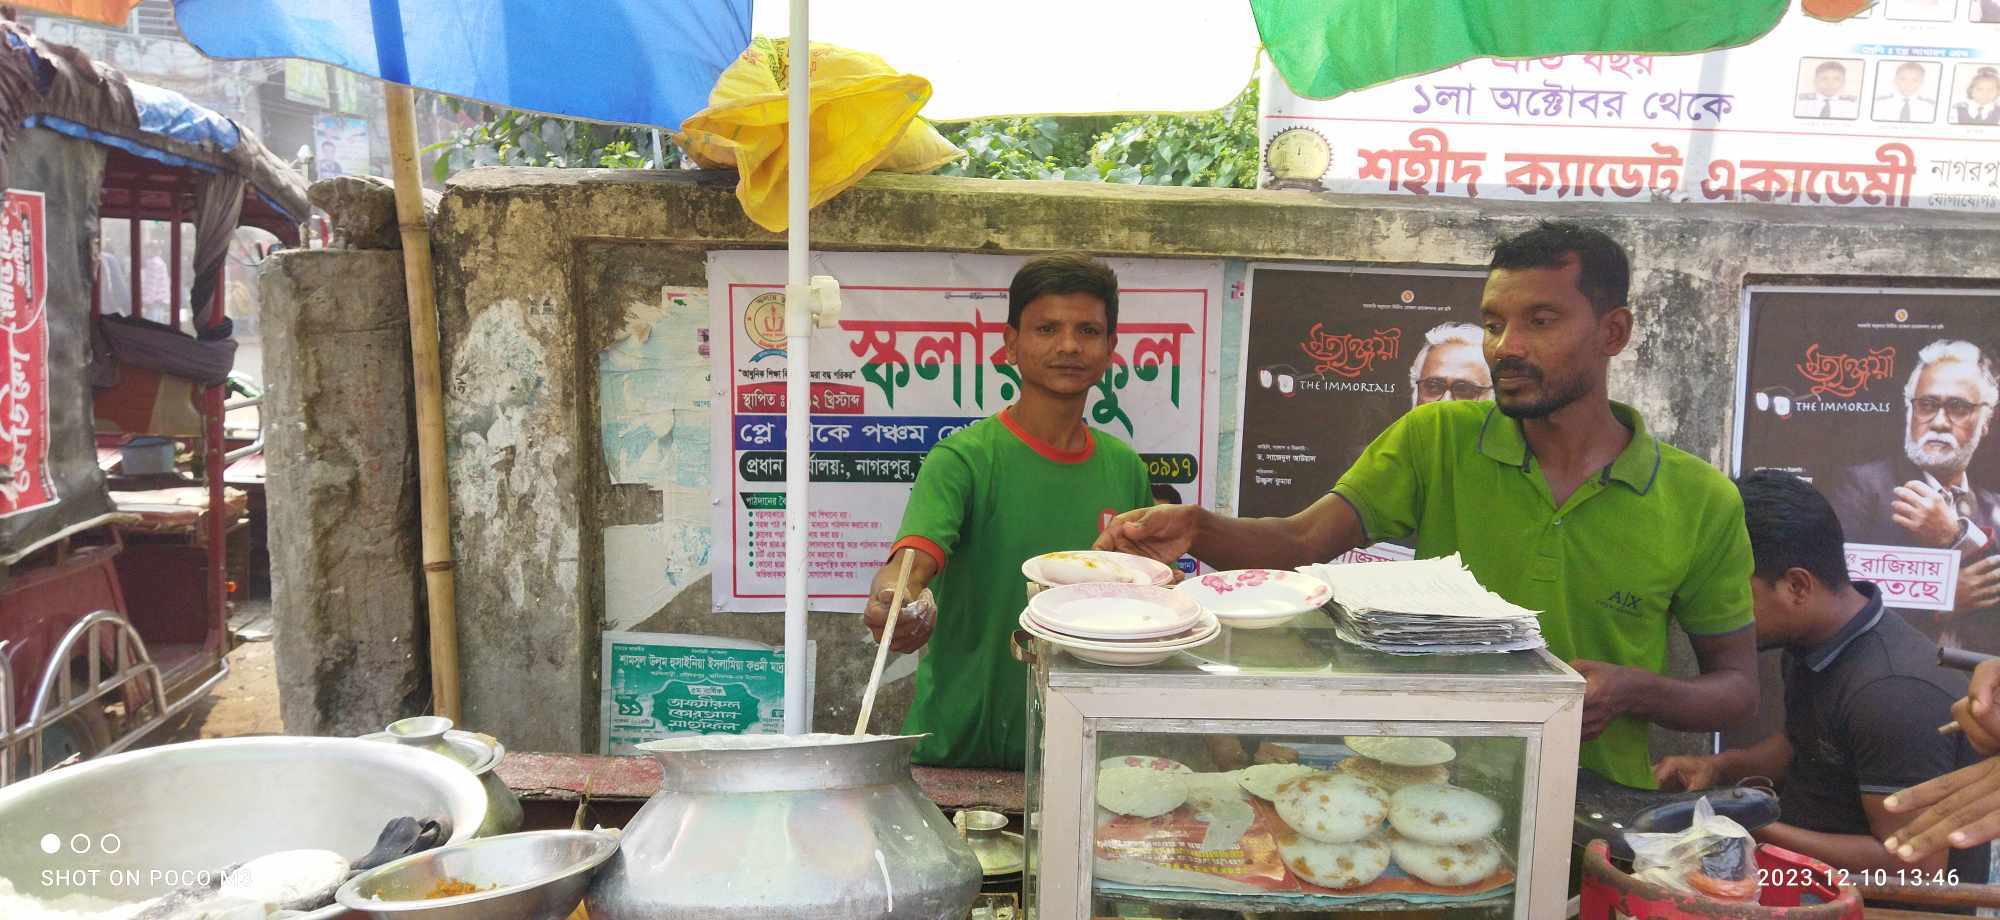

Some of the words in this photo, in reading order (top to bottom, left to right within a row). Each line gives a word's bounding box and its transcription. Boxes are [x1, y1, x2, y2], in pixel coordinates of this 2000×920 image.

[1413, 83, 1477, 116] ১লা
[1490, 79, 1628, 119] অক্টোবর
[1643, 88, 1734, 122] থেকে
[1358, 127, 1487, 198] শহীদ
[1504, 141, 1683, 198] ক্যাডেট
[1700, 142, 1917, 207] একাডেমী
[1300, 381, 1321, 391] THE
[1325, 381, 1396, 393] IMMORTALS
[742, 388, 776, 409] স্থাপিত
[1796, 402, 1817, 411] THE
[1821, 402, 1891, 413] IMMORTALS
[740, 422, 775, 444] প্লে
[862, 422, 929, 444] পঞ্চম
[747, 458, 785, 475] প্রধান
[855, 458, 915, 479] নাগরপুর,
[1861, 553, 1944, 577] রাজিয়ায়
[708, 656, 744, 671] ইসলামিয়া
[622, 704, 640, 714] ১১
